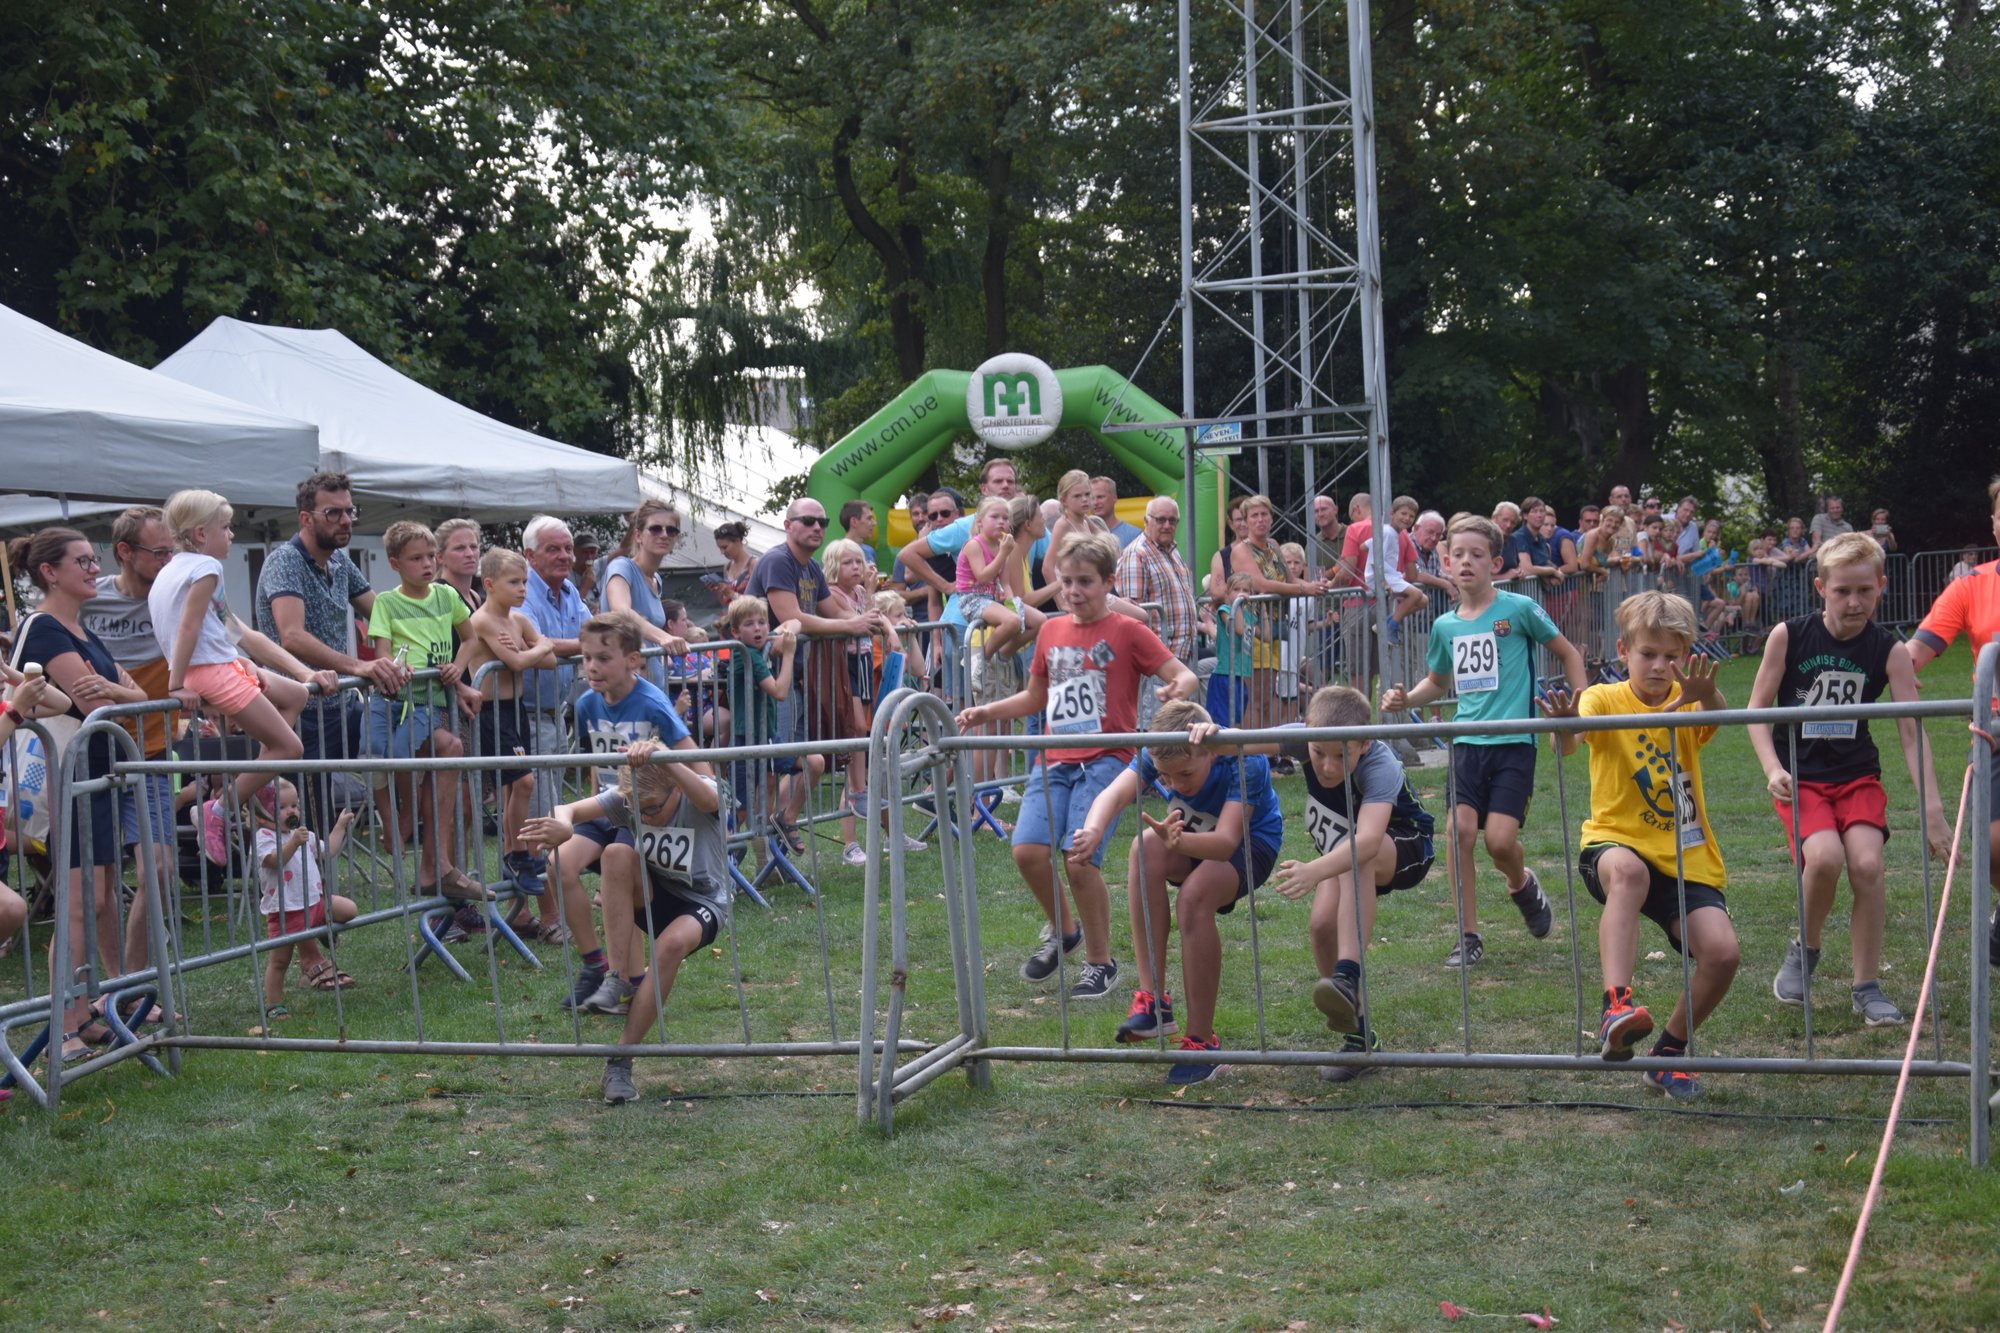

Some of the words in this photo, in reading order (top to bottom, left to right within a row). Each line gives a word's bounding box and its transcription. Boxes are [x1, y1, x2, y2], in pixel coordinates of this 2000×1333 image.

[830, 396, 938, 477] www.cm.be
[982, 427, 1040, 437] MUTUALITEIT
[89, 615, 153, 634] KAMPIO
[1457, 639, 1494, 674] 259
[1798, 654, 1836, 674] SUNRISE
[1052, 683, 1093, 721] 256
[1811, 680, 1857, 706] 258
[1309, 806, 1348, 855] 257
[643, 832, 690, 872] 262
[696, 906, 711, 923] 10
